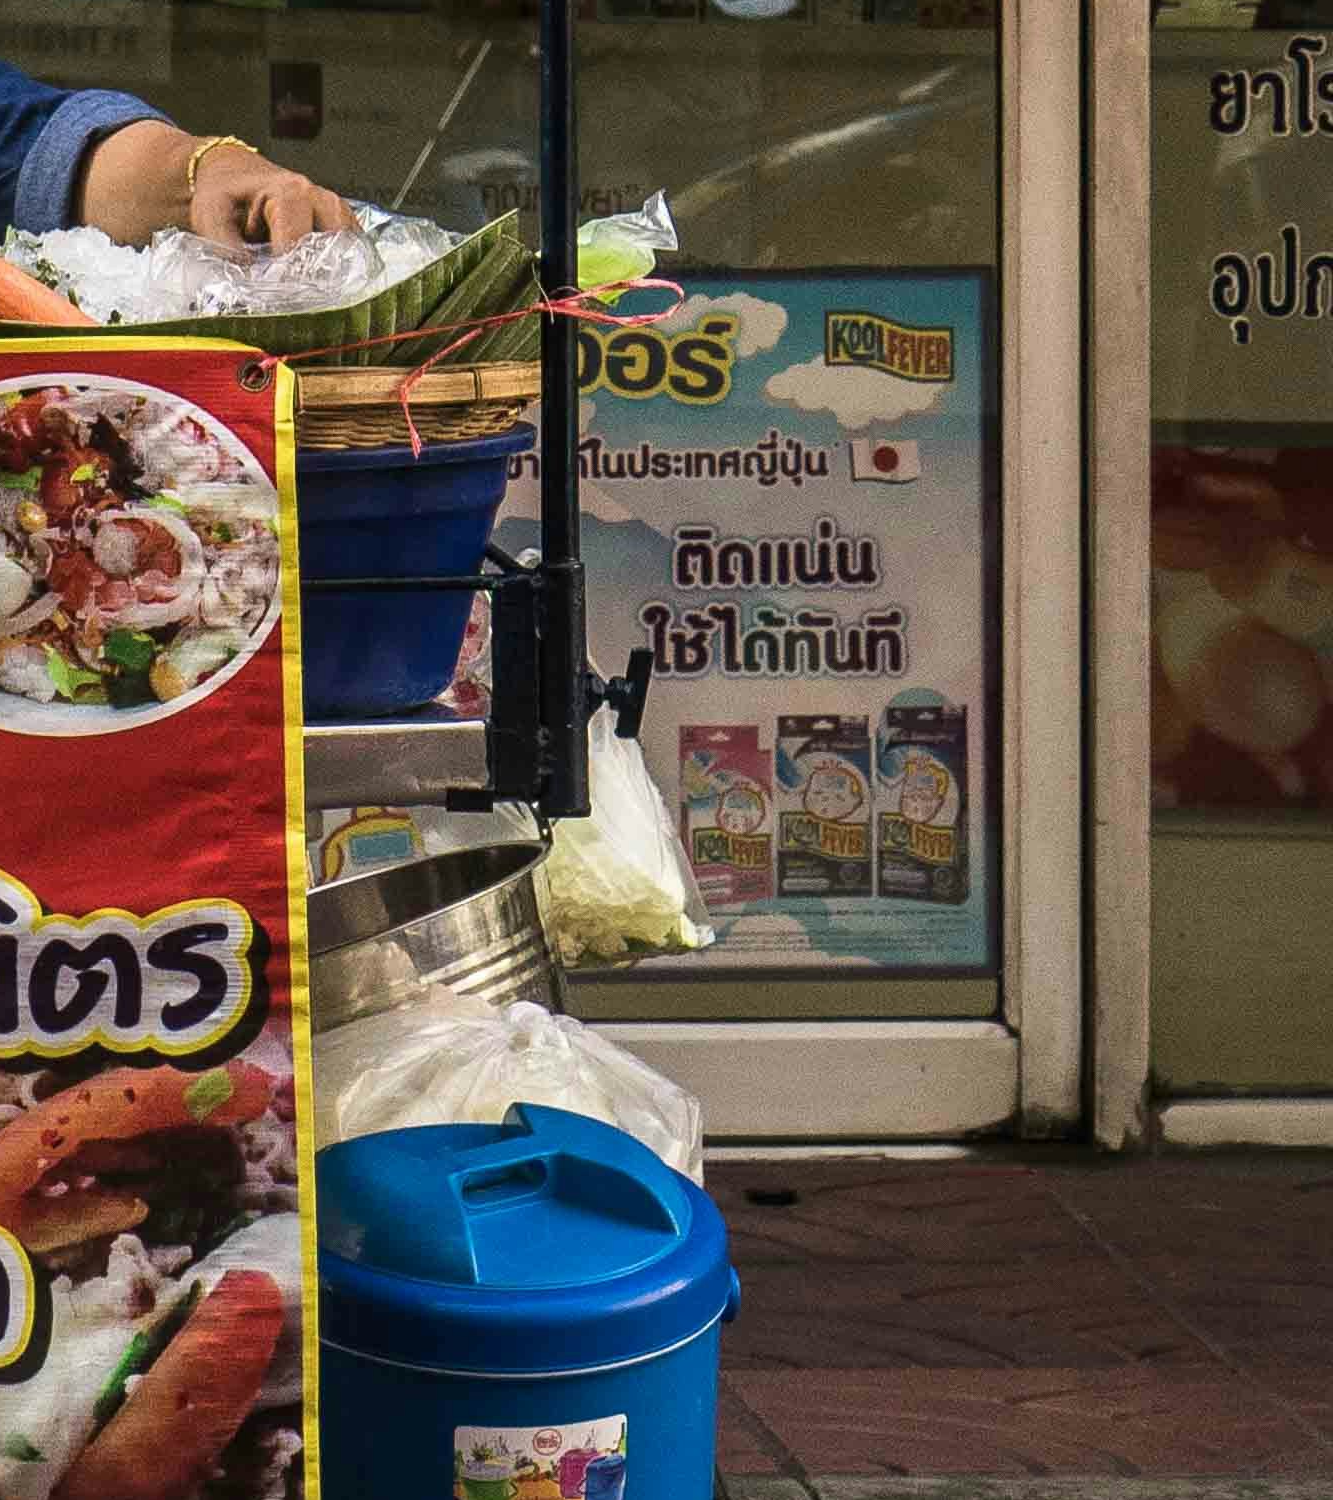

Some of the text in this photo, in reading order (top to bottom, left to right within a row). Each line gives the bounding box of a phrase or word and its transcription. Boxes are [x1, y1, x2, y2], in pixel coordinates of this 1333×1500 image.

[672, 519, 878, 589] ติดแน่น
[642, 605, 907, 677] ใช้ได้ทันที
